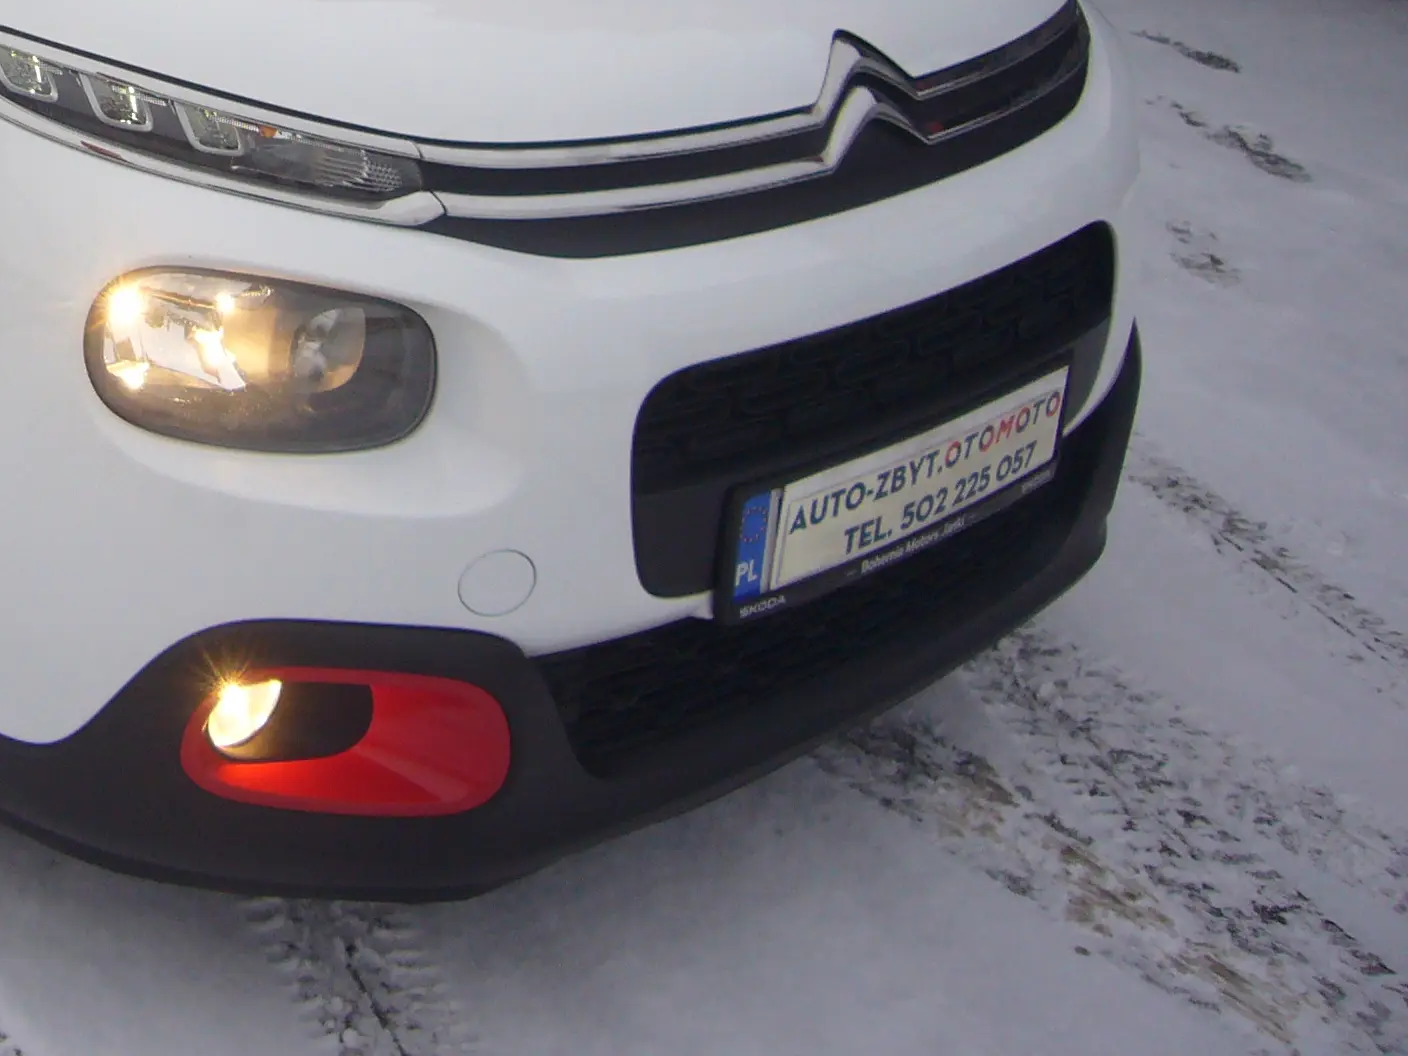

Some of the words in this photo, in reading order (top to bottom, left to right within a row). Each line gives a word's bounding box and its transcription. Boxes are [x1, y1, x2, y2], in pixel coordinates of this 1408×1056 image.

[844, 515, 893, 555] TEL.
[900, 487, 949, 530] 502
[952, 463, 992, 506] 225
[995, 439, 1038, 482] 057
[735, 559, 758, 586] PL
